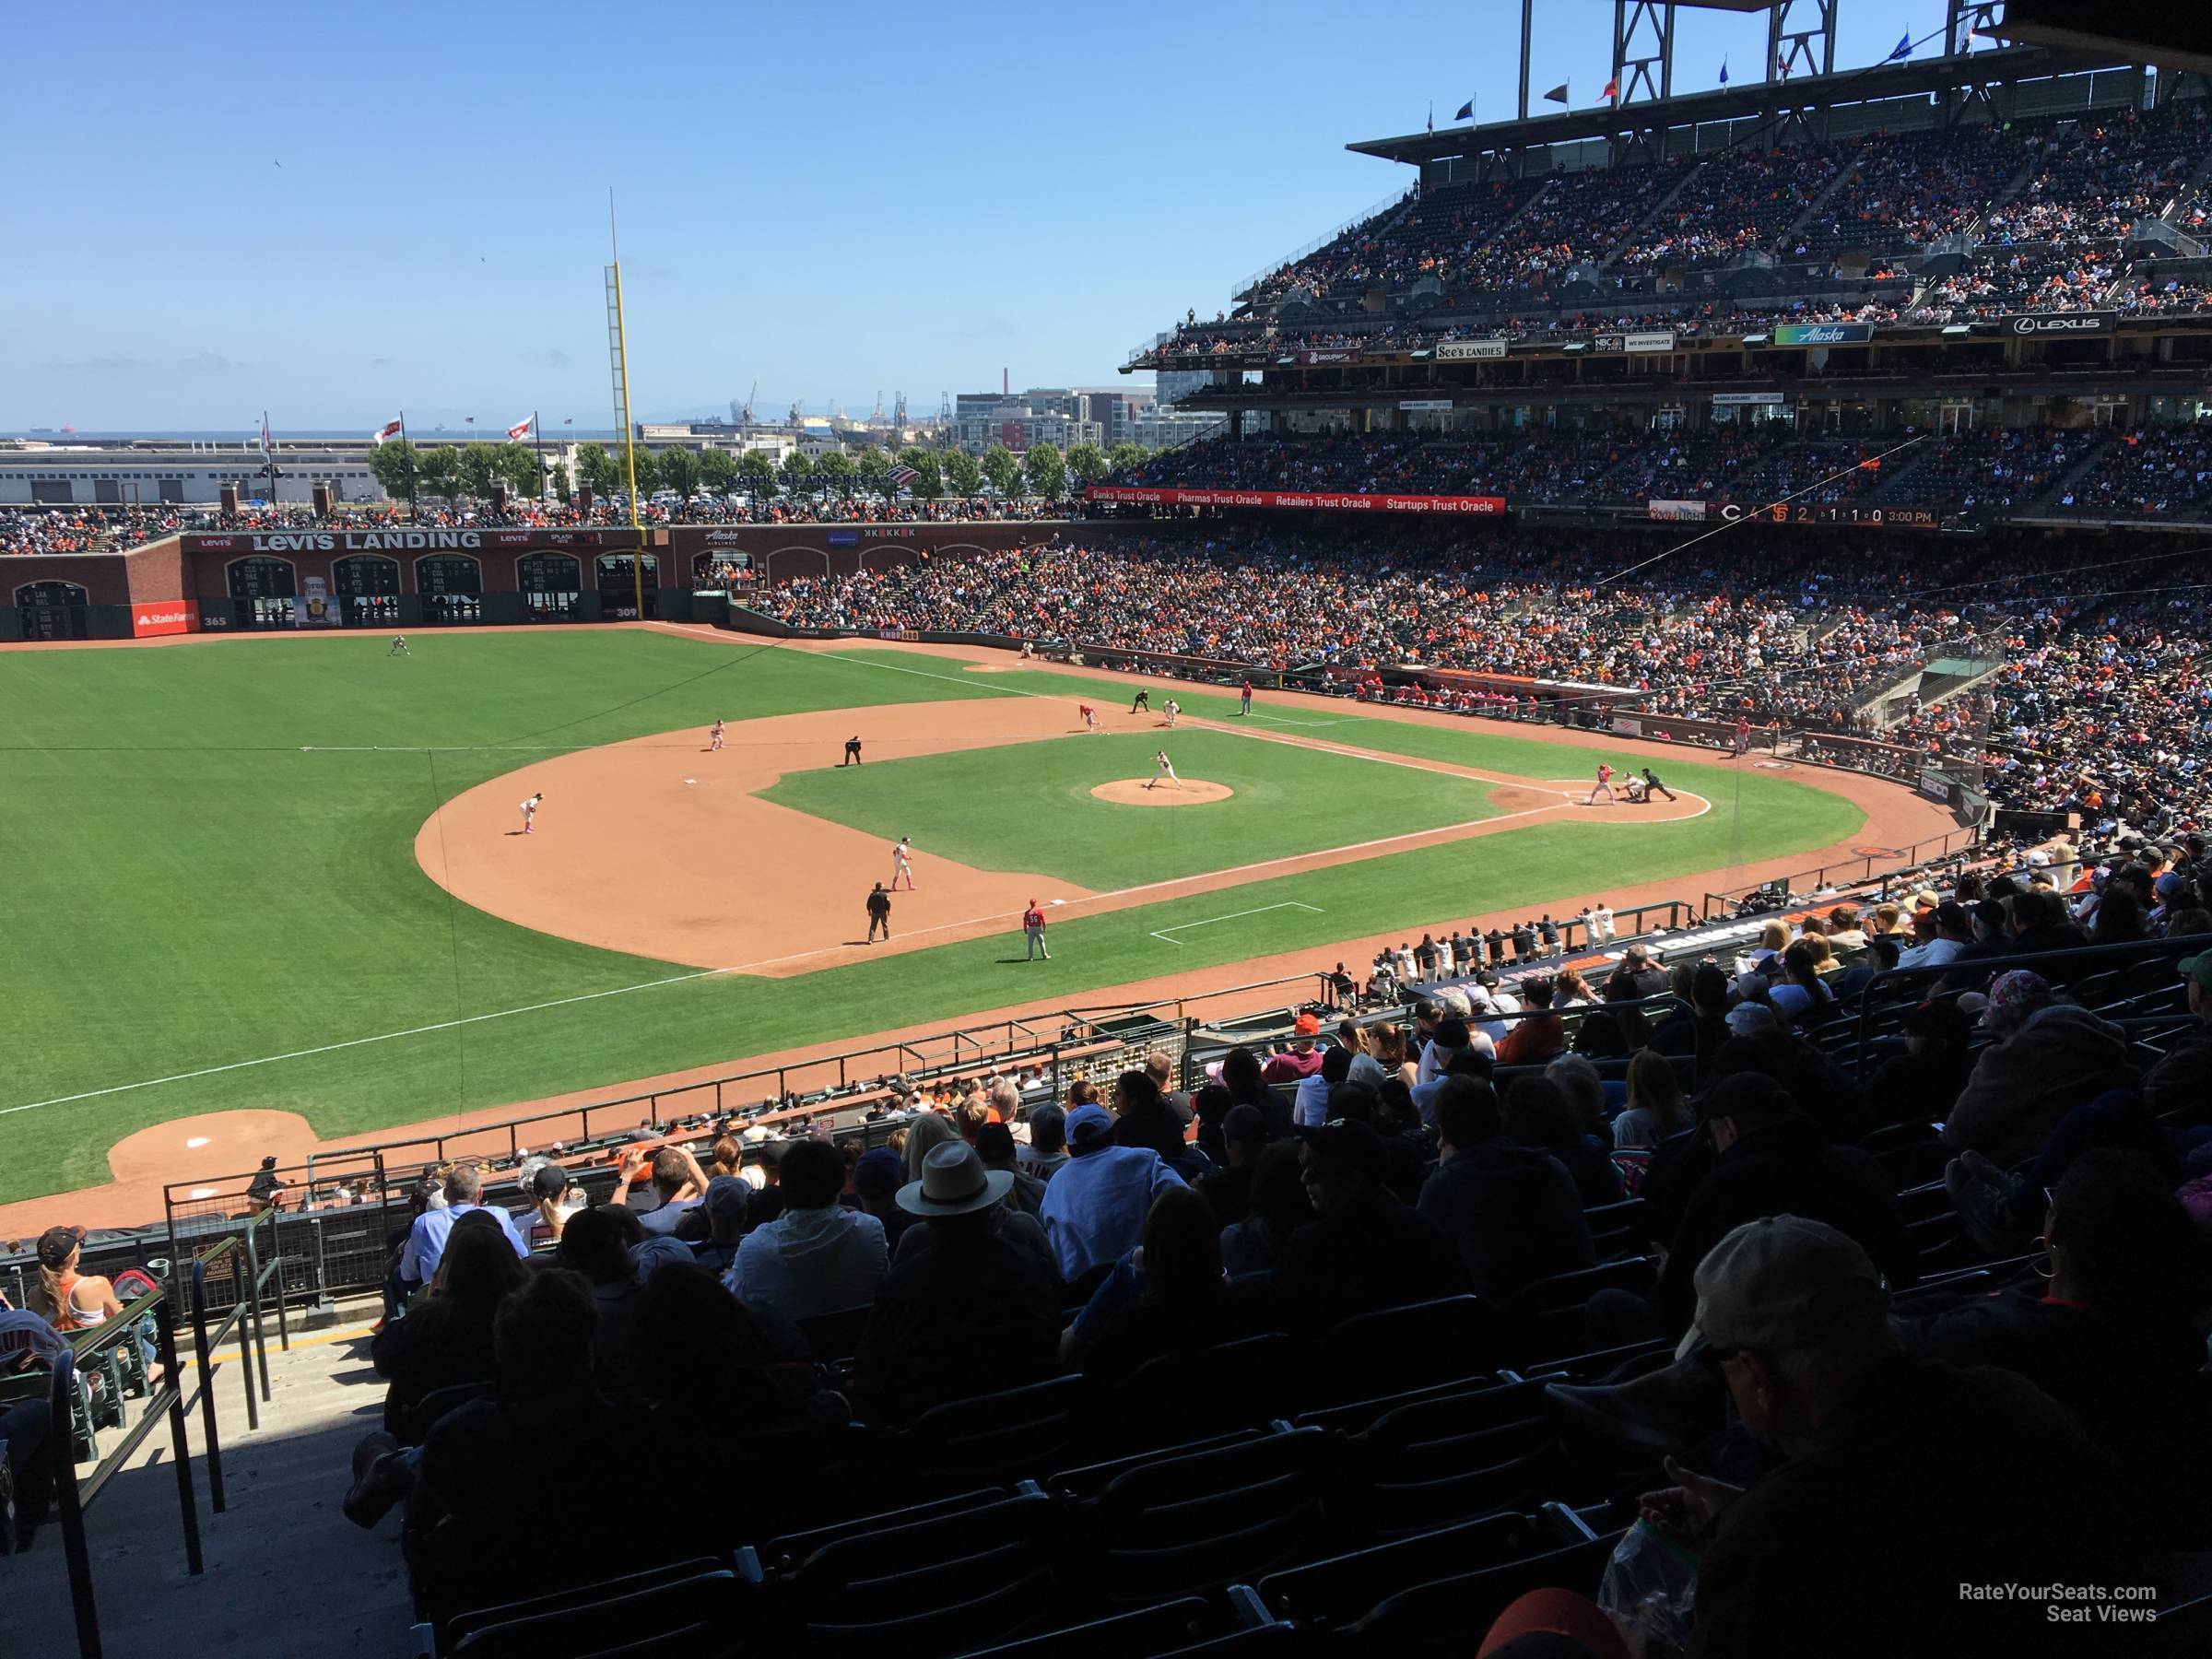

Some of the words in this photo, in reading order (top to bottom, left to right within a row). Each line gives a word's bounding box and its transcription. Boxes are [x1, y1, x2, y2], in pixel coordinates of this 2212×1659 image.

[2036, 317, 2100, 330] LEXUS
[1798, 326, 1845, 343] Alaska
[1595, 337, 1612, 347] NBC
[1438, 346, 1464, 358] See's
[1466, 347, 1502, 357] CANDIES
[726, 475, 772, 486] BANK
[778, 475, 798, 485] OF
[805, 474, 881, 485] AMERICA
[1093, 489, 1115, 500] Banks
[1116, 490, 1135, 500] Trust
[1136, 491, 1160, 501] Oracle
[1177, 492, 1211, 503] Pharmas
[1213, 493, 1234, 504] Trust
[1236, 494, 1262, 505] Oracle
[1276, 495, 1313, 506] Retailers
[1315, 497, 1338, 508] Trust
[1341, 497, 1371, 509] Oracle
[1386, 498, 1430, 512] Startups
[1431, 499, 1458, 512] Trust
[1460, 500, 1494, 512] Oracle
[1798, 508, 1806, 522] 2
[1830, 508, 1837, 521] 1
[1852, 509, 1858, 522] 1
[1872, 509, 1882, 522] 0
[1888, 511, 1912, 523] 3:00
[1915, 512, 1932, 524] PM
[346, 532, 481, 549] LANDING
[705, 530, 738, 541] Alaska
[617, 608, 637, 617] 309
[205, 618, 227, 627] 365
[880, 630, 901, 640] KNBR
[903, 630, 919, 641] 680
[1921, 776, 1948, 799] GEICO
